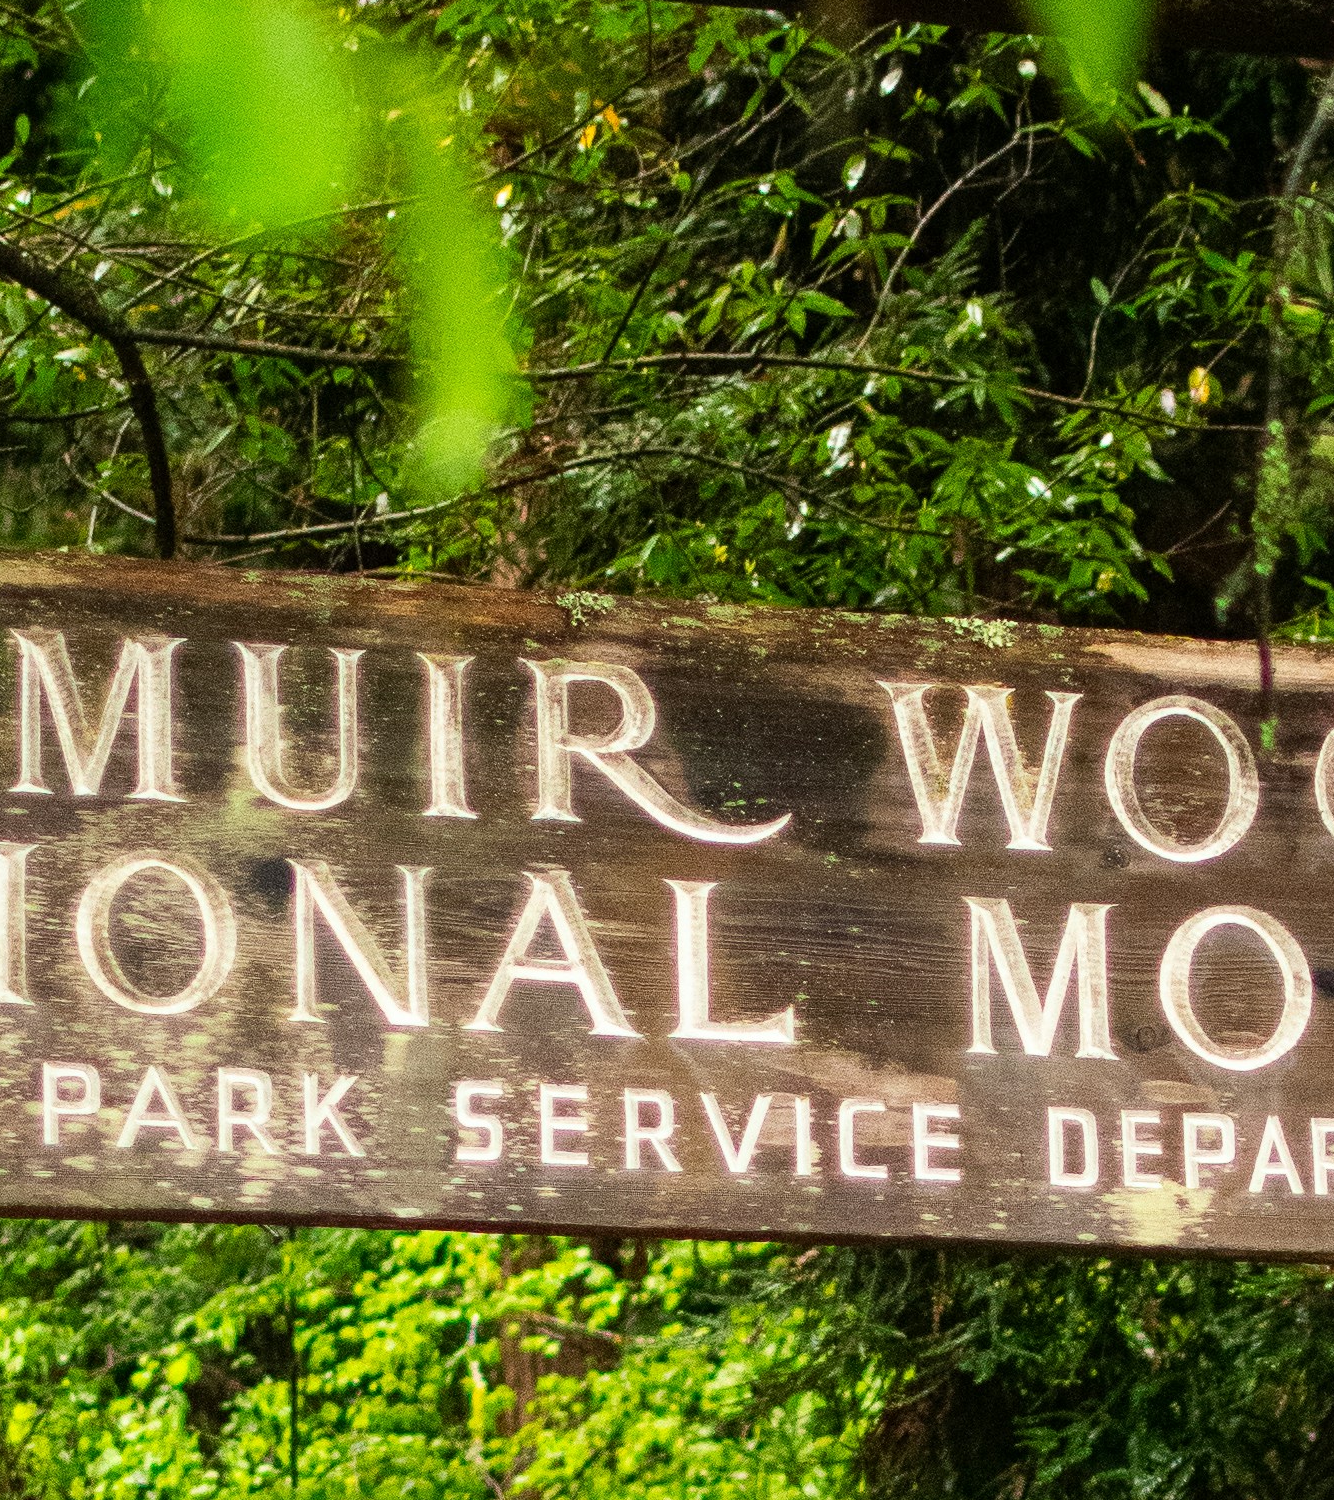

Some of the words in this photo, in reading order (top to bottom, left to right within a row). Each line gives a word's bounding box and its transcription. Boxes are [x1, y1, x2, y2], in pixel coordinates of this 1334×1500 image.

[9, 628, 792, 844] MUIR
[41, 1060, 366, 1159] PARK
[453, 1077, 963, 1184] SERVICE
